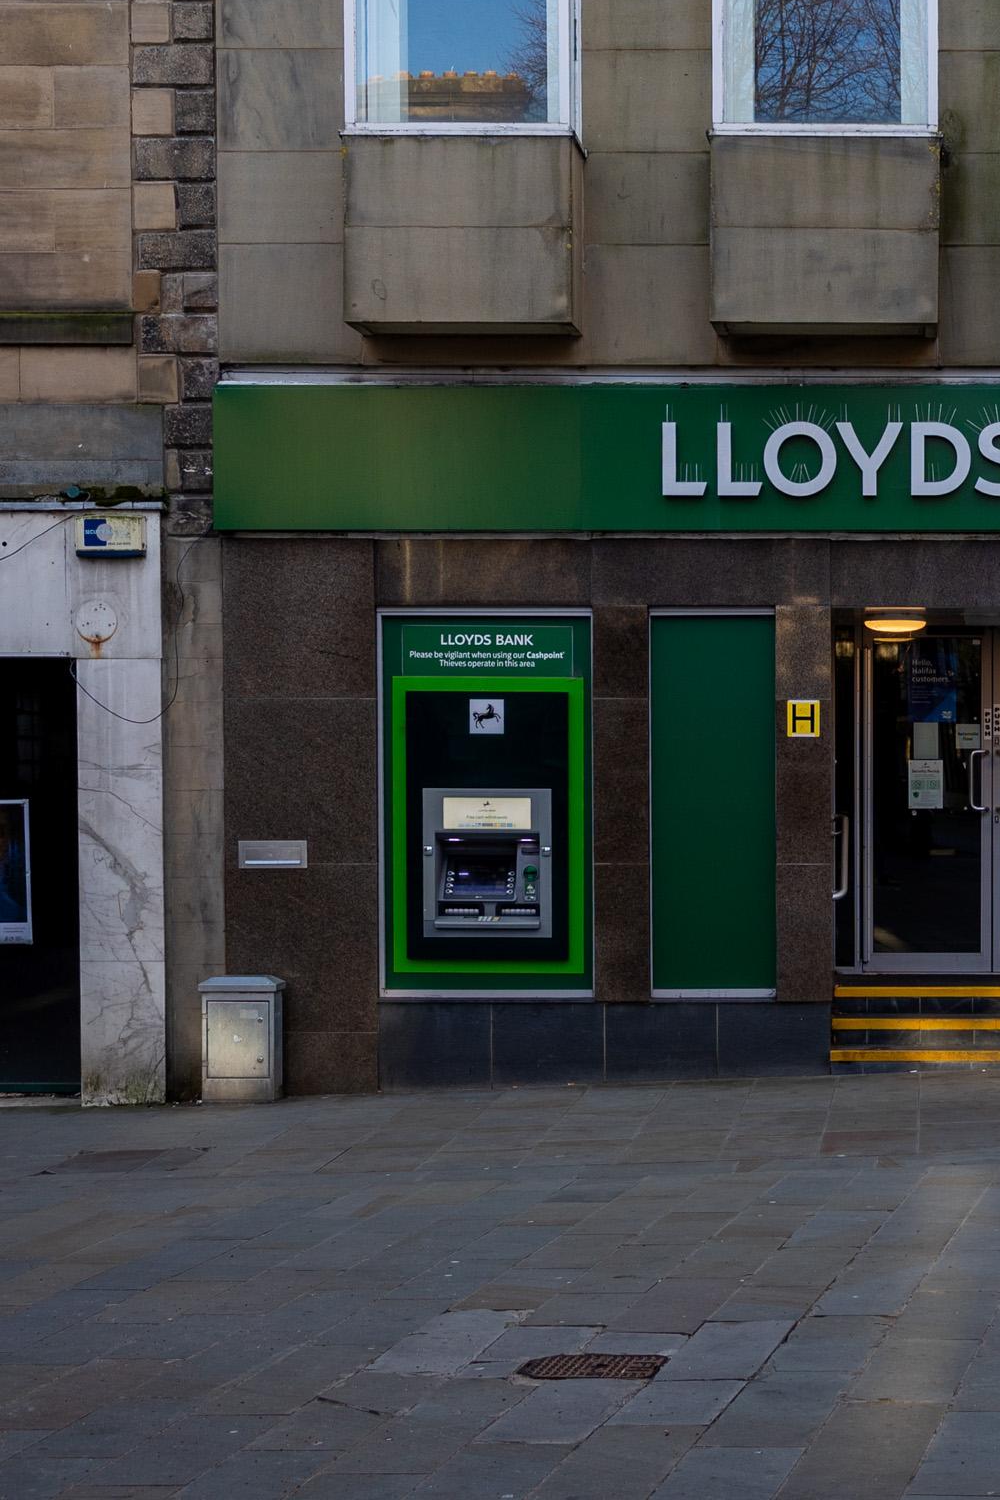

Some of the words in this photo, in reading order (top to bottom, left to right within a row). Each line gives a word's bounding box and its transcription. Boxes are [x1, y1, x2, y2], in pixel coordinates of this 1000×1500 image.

[440, 634, 492, 646] LLOYDS
[496, 634, 534, 646] BANK
[409, 650, 433, 659] Please
[434, 650, 443, 659] be
[444, 650, 470, 661] vigilant
[471, 651, 492, 659] when
[492, 651, 512, 661] using
[439, 659, 467, 667] Thieves
[468, 660, 496, 669] operate
[496, 659, 504, 667] in
[505, 659, 518, 667] this
[792, 703, 815, 733] H
